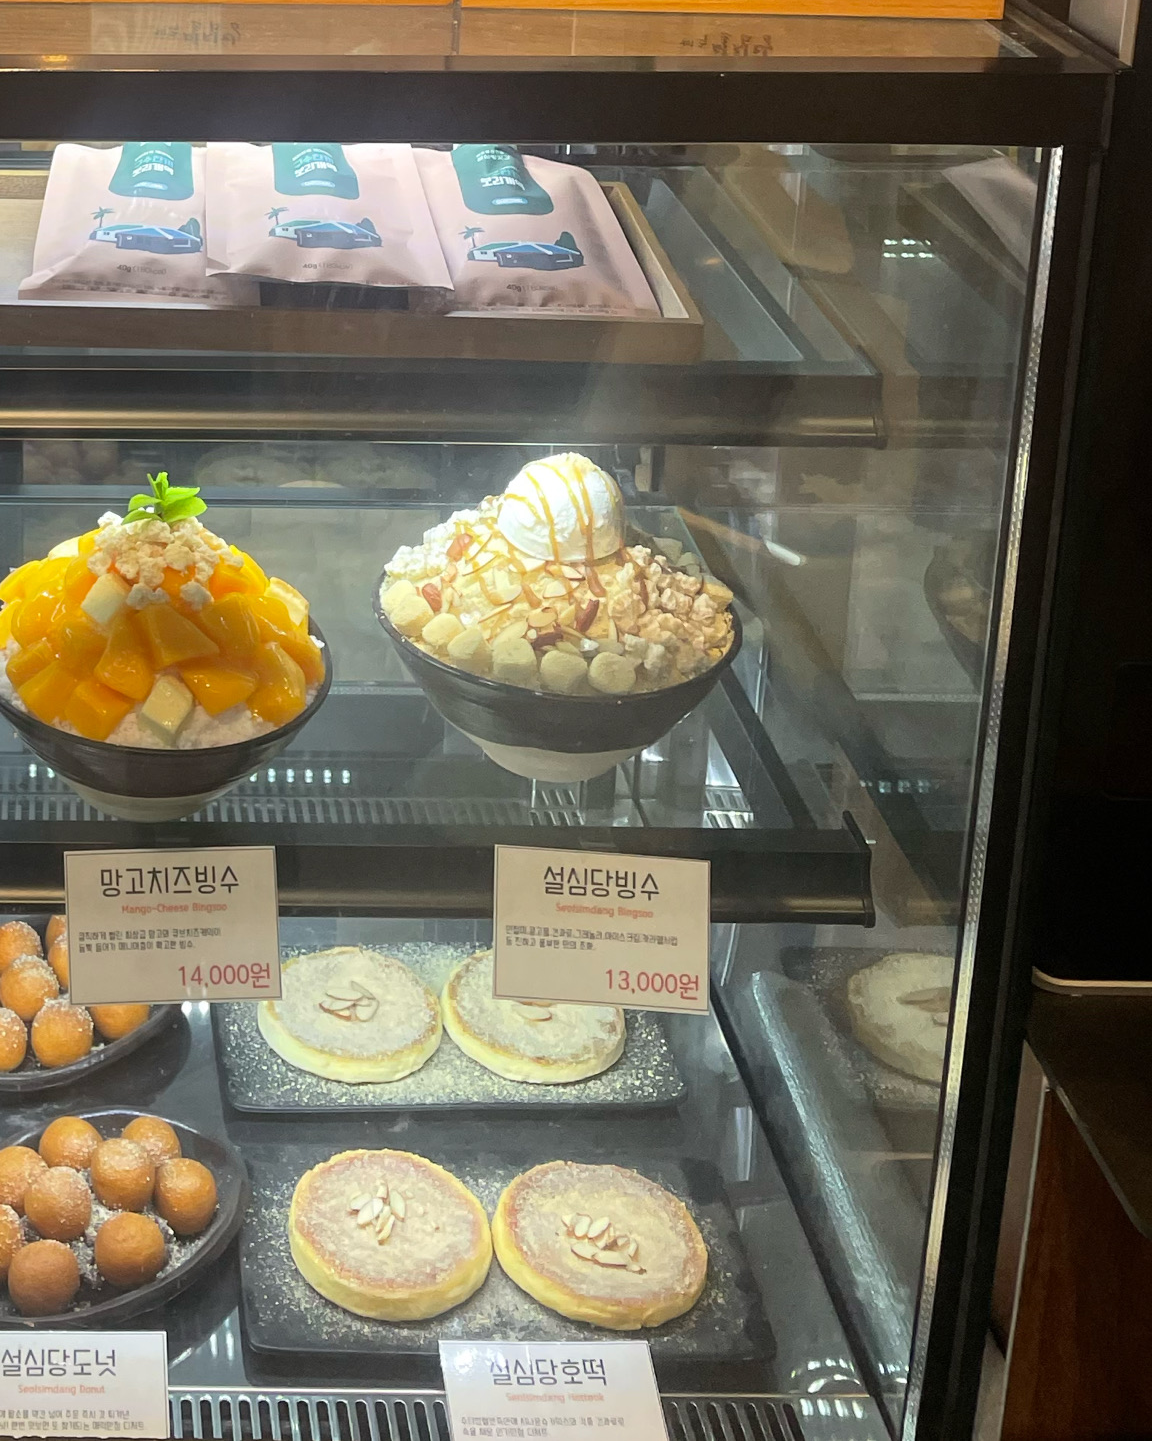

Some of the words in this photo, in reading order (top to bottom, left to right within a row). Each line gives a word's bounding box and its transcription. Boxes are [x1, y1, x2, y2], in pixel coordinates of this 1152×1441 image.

[101, 866, 239, 897] 망고치즈빙수
[544, 866, 660, 901] 설심당빙수
[178, 962, 271, 989] 14,000원
[605, 969, 699, 1000] 13,000원
[1, 1349, 117, 1377] 설심당도넛
[490, 1358, 607, 1386] 설심당호떡
